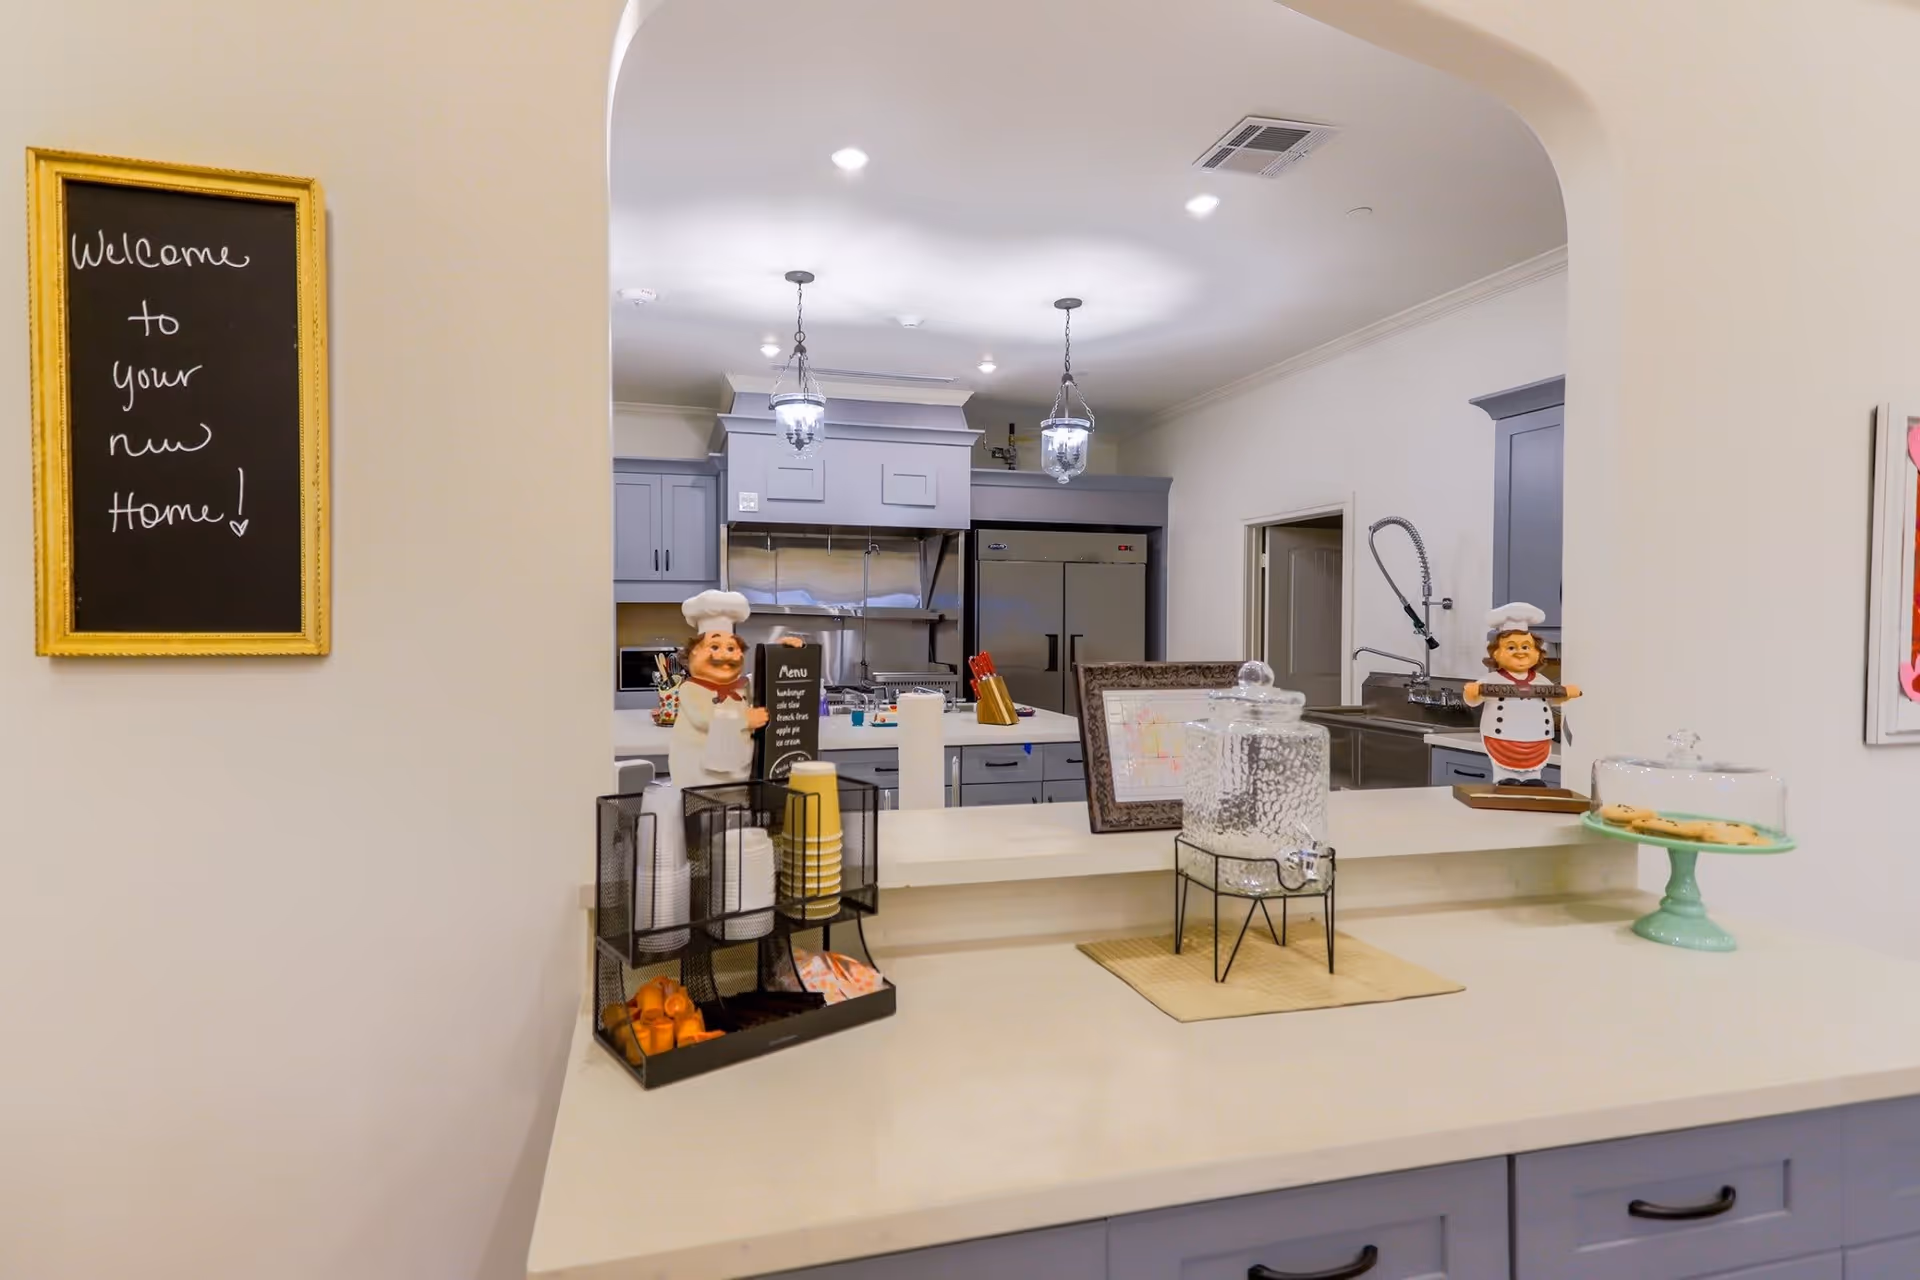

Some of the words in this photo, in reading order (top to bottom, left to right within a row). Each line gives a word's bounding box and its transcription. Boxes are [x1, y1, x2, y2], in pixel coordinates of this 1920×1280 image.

[71, 229, 250, 269] Welcome
[127, 300, 180, 337] to
[112, 360, 203, 412] your
[779, 665, 808, 678] Menu
